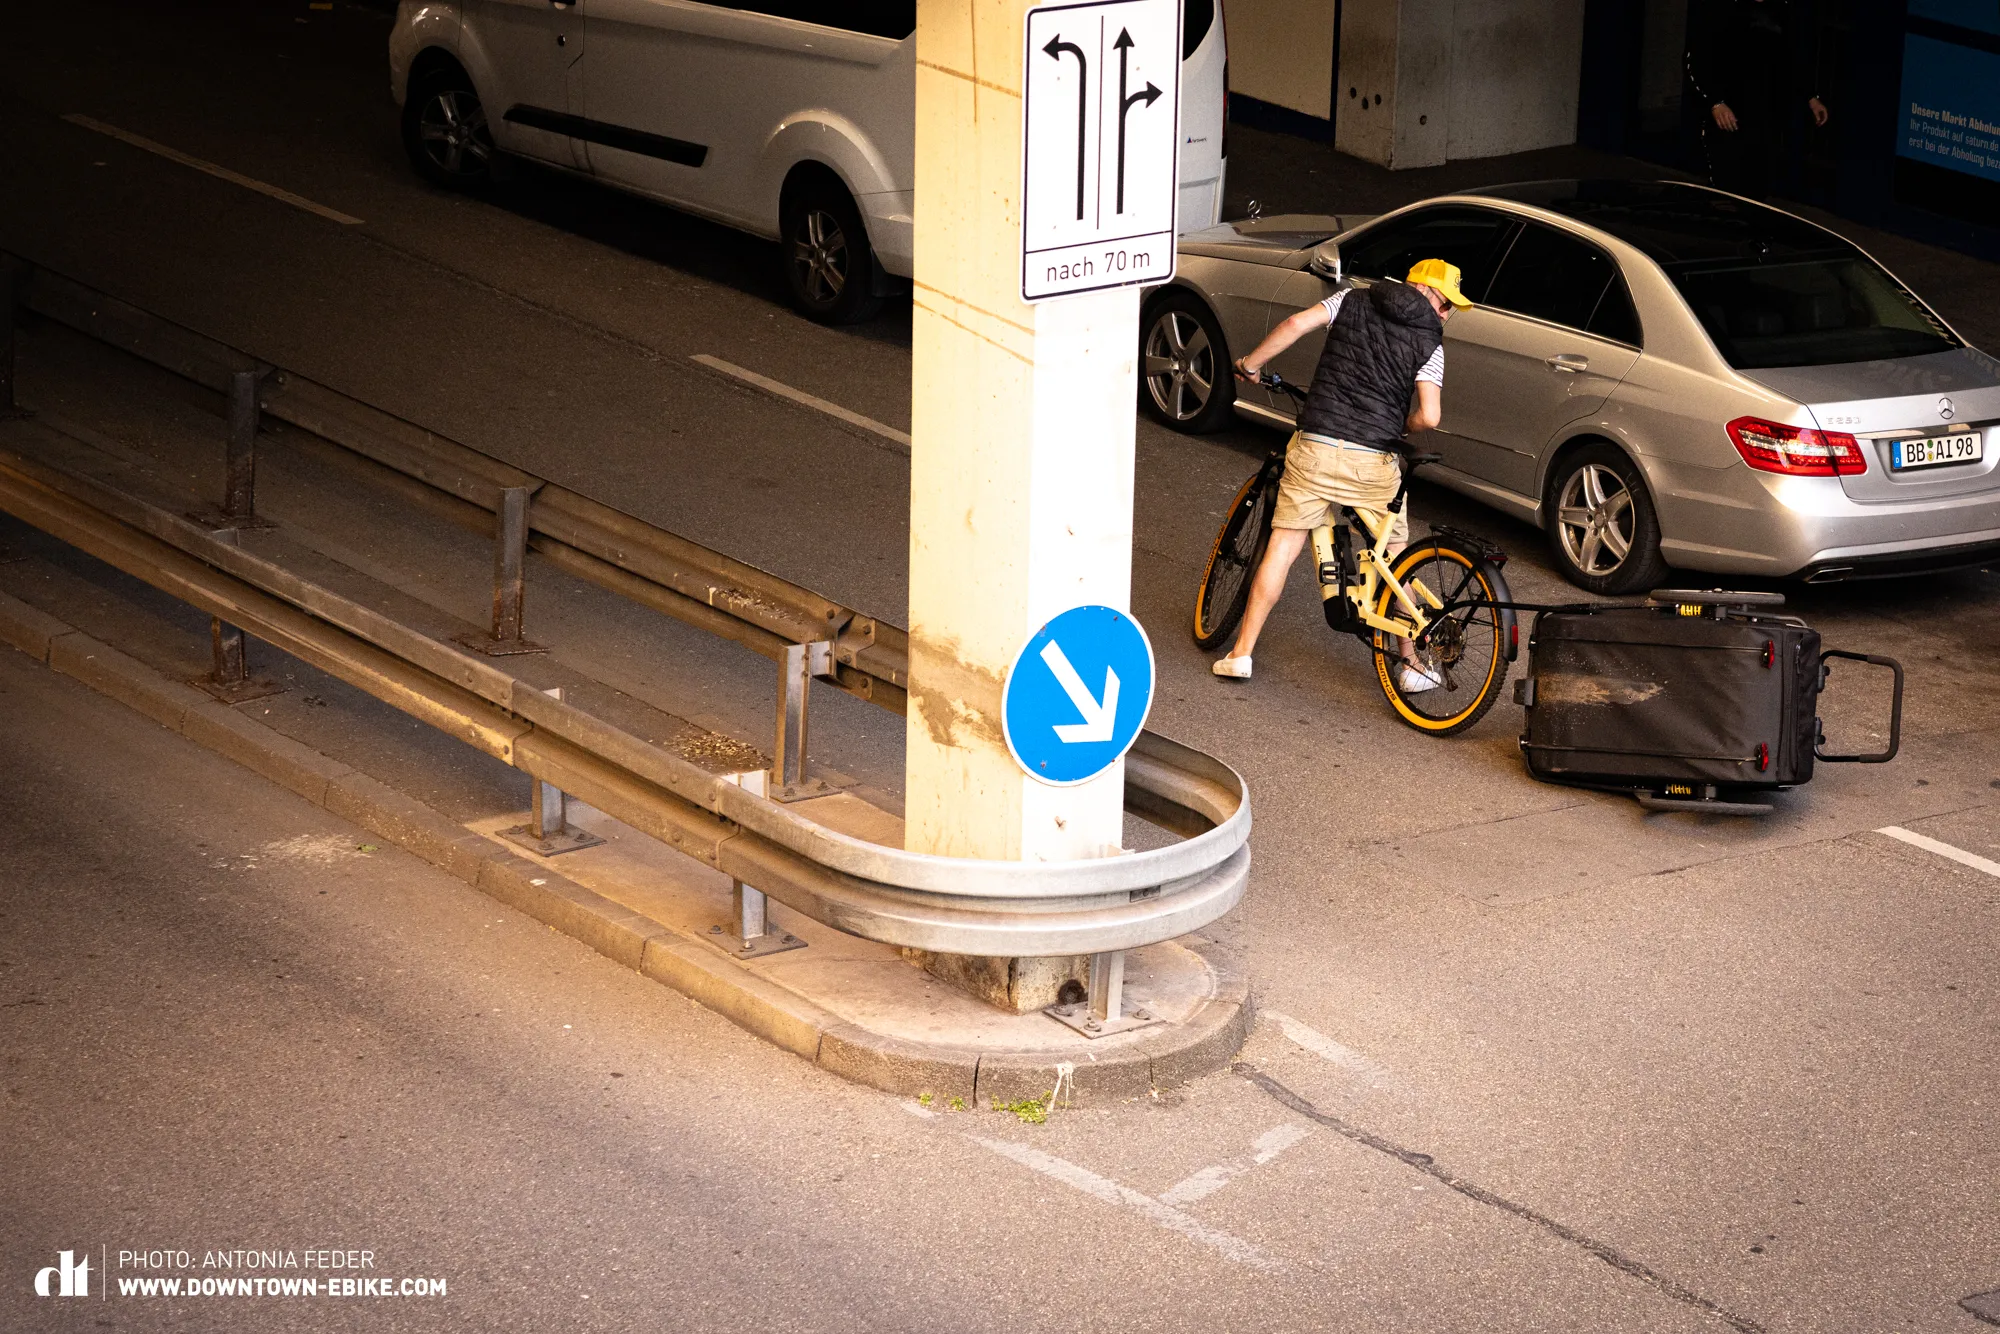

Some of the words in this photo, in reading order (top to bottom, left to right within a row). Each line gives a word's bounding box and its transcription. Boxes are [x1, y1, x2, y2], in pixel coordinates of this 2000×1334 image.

[1911, 102, 1940, 120] Unsere
[1941, 110, 1967, 127] Markt
[1910, 118, 1921, 131] Ihr
[1922, 121, 1950, 139] Produkt
[1952, 131, 1964, 143] auf
[1965, 135, 1999, 152] saturn.de
[1908, 137, 1923, 149] erst
[1925, 138, 1936, 152] bei
[1937, 143, 1950, 155] der
[1951, 146, 1985, 167] Abholung
[1047, 256, 1093, 282] nach
[1105, 250, 1127, 273] 70
[1132, 252, 1150, 269] m
[1906, 442, 1926, 463] BB
[1936, 439, 1953, 460] AI
[1956, 437, 1974, 457] 98
